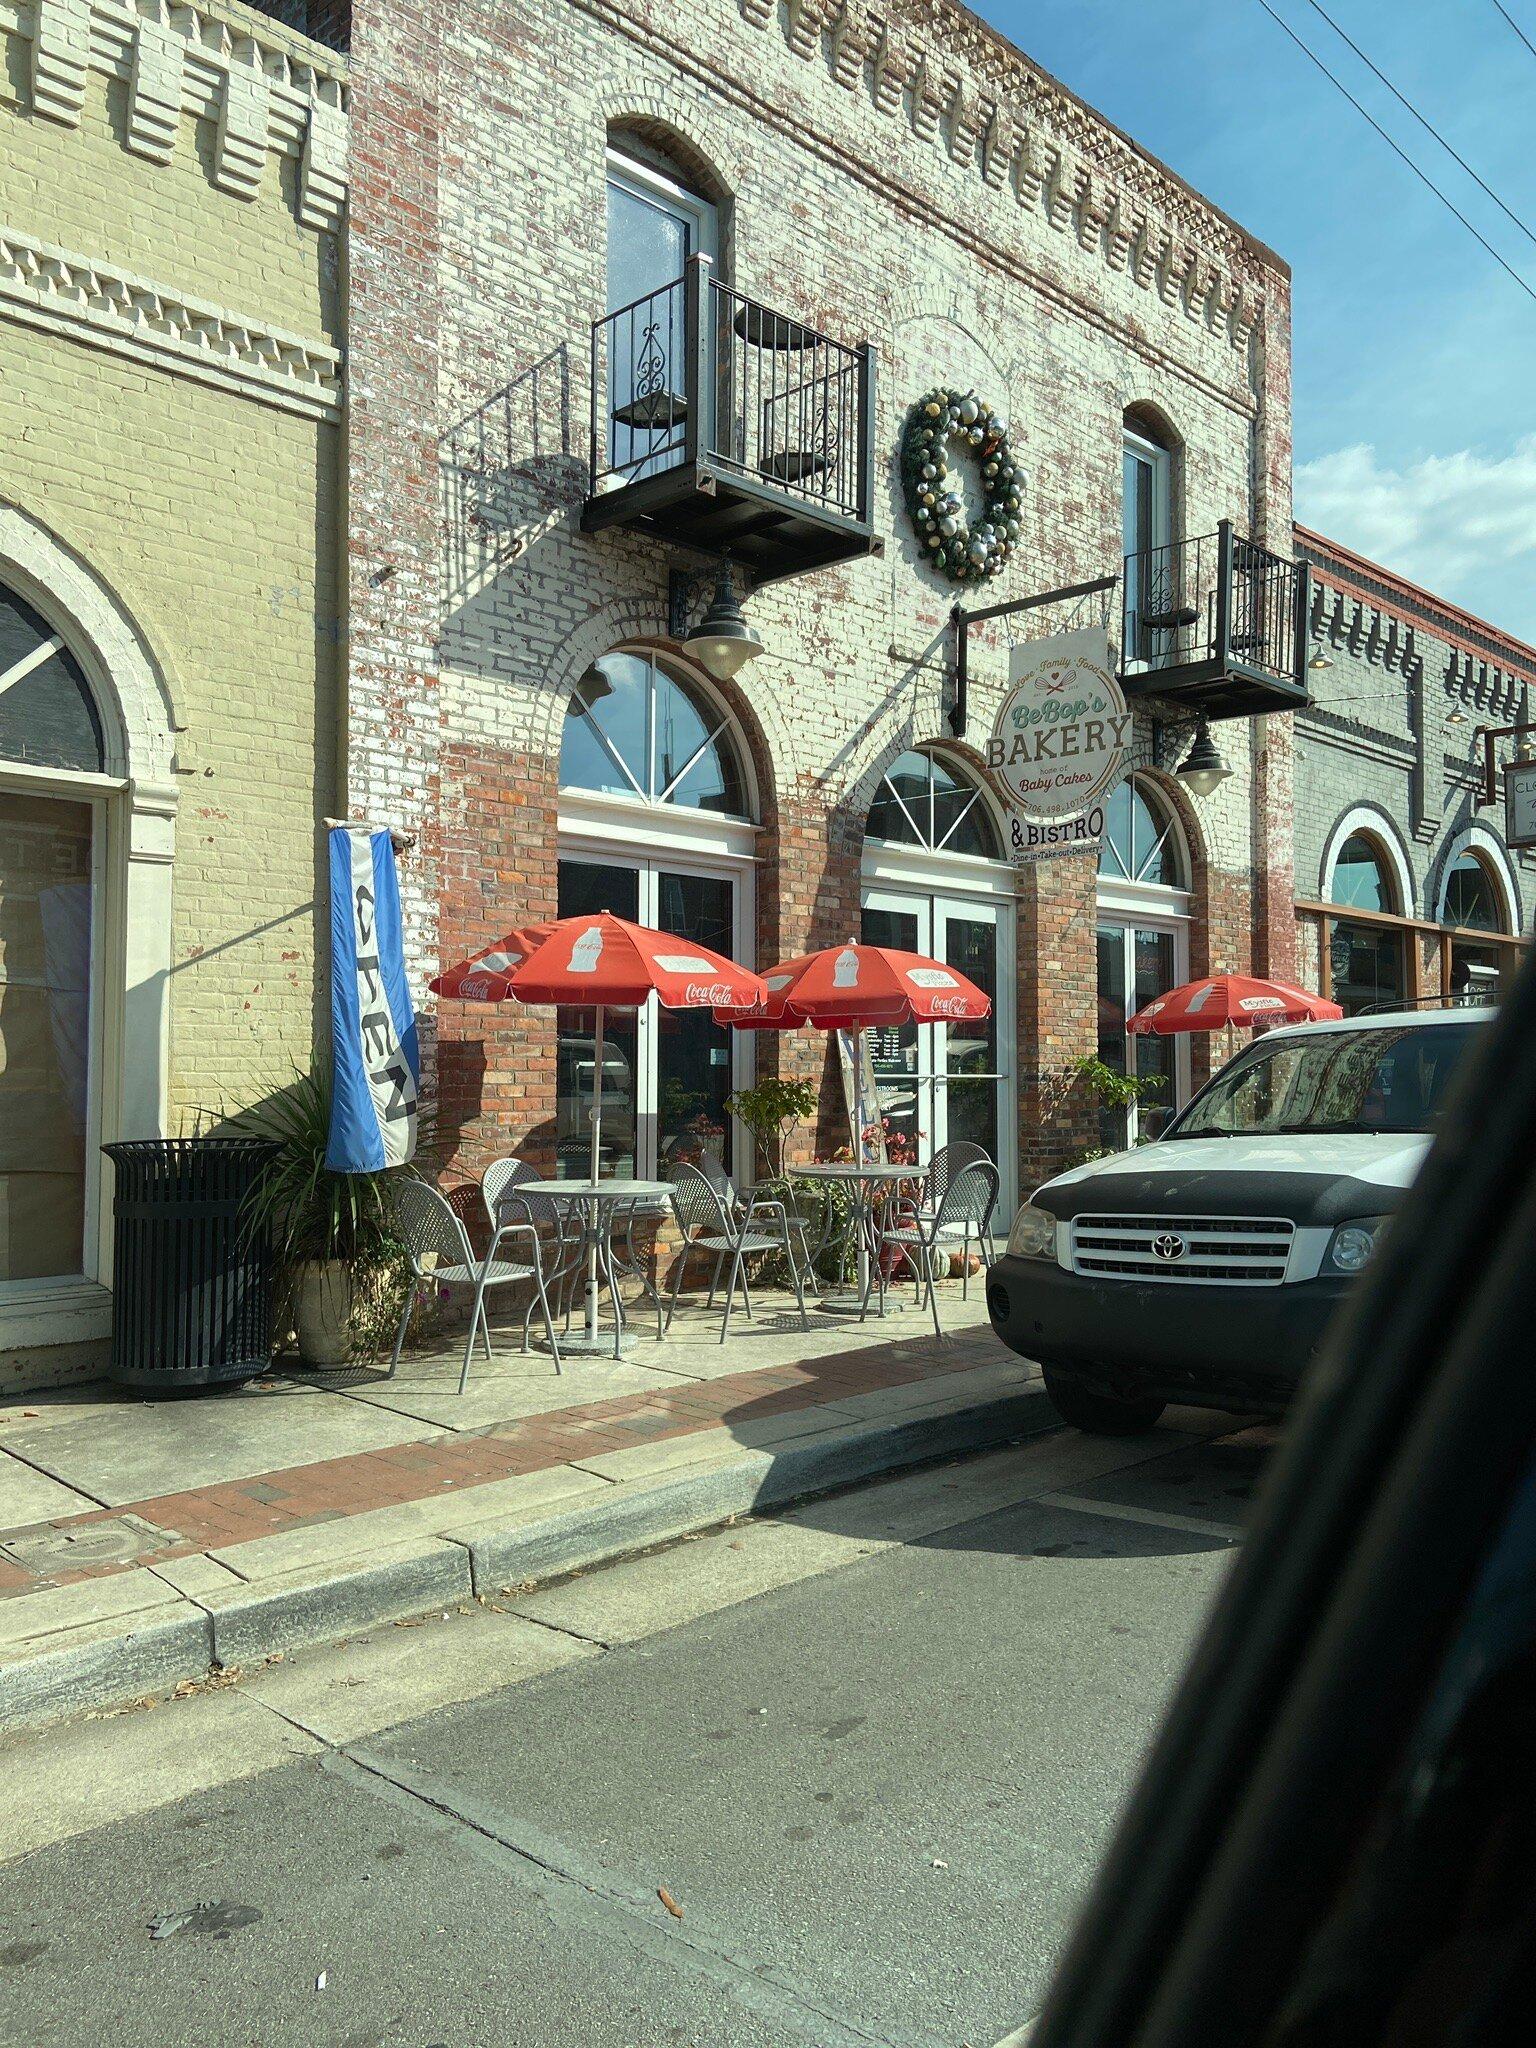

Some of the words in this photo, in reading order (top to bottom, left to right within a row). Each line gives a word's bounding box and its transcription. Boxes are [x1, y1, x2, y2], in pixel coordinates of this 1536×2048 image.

[1015, 671, 1035, 688] Love
[1040, 657, 1071, 672] Family
[1076, 657, 1100, 674] Food
[1012, 692, 1107, 729] BeBop's
[987, 715, 1131, 769] BAKERY
[1019, 778, 1053, 793] Baby
[1055, 772, 1093, 787] Cakes
[1027, 807, 1103, 845] BISTRO
[1014, 853, 1037, 862] Dine-in
[1040, 850, 1070, 859] Take-out
[1072, 846, 1099, 855] Delivery
[686, 983, 733, 1004] Coca-Cola
[931, 995, 968, 1015] Coca-Cola
